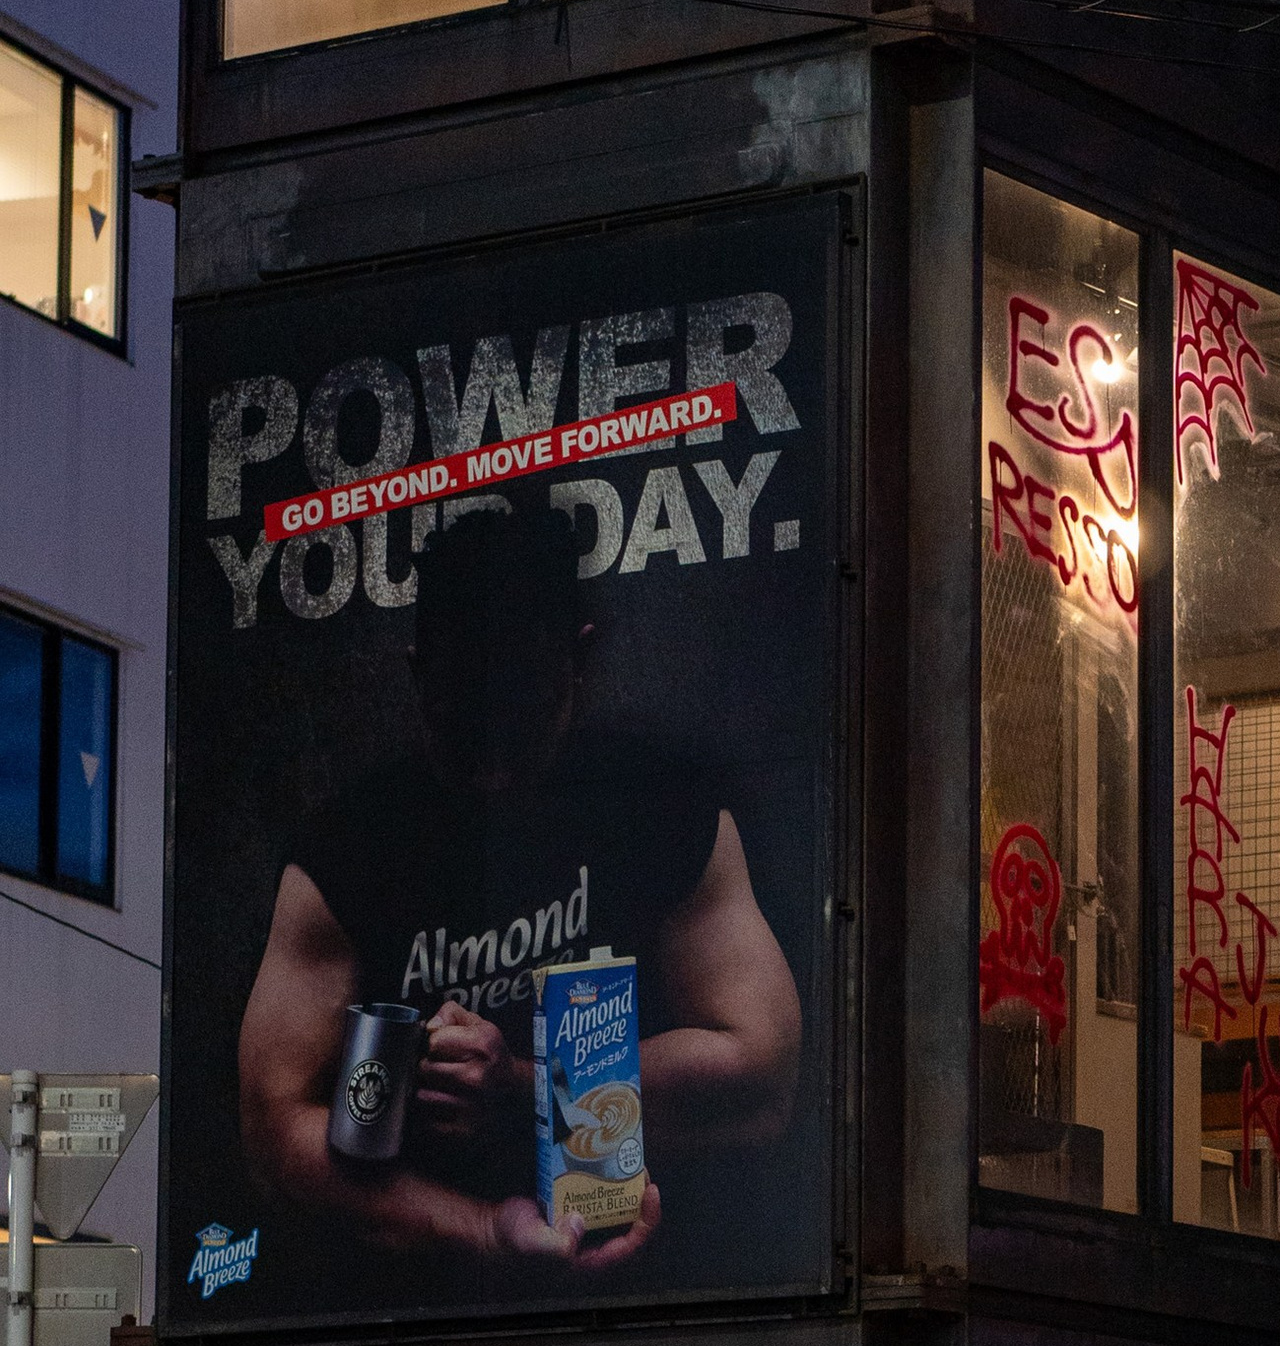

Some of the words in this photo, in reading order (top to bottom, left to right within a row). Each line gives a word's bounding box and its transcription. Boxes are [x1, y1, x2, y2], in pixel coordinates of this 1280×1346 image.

[206, 291, 802, 521] POWER
[281, 498, 326, 532] GO
[330, 464, 458, 520] BEYOND.
[467, 433, 553, 485] MOVE
[561, 394, 723, 456] FORWARD.
[549, 450, 800, 581] DAY.
[401, 865, 589, 999] Almond
[554, 981, 633, 1049] Almond
[573, 1017, 627, 1068] Breeze
[606, 1195, 639, 1211] BLEND
[187, 1228, 259, 1283] Almond
[202, 1259, 251, 1297] Breeze
